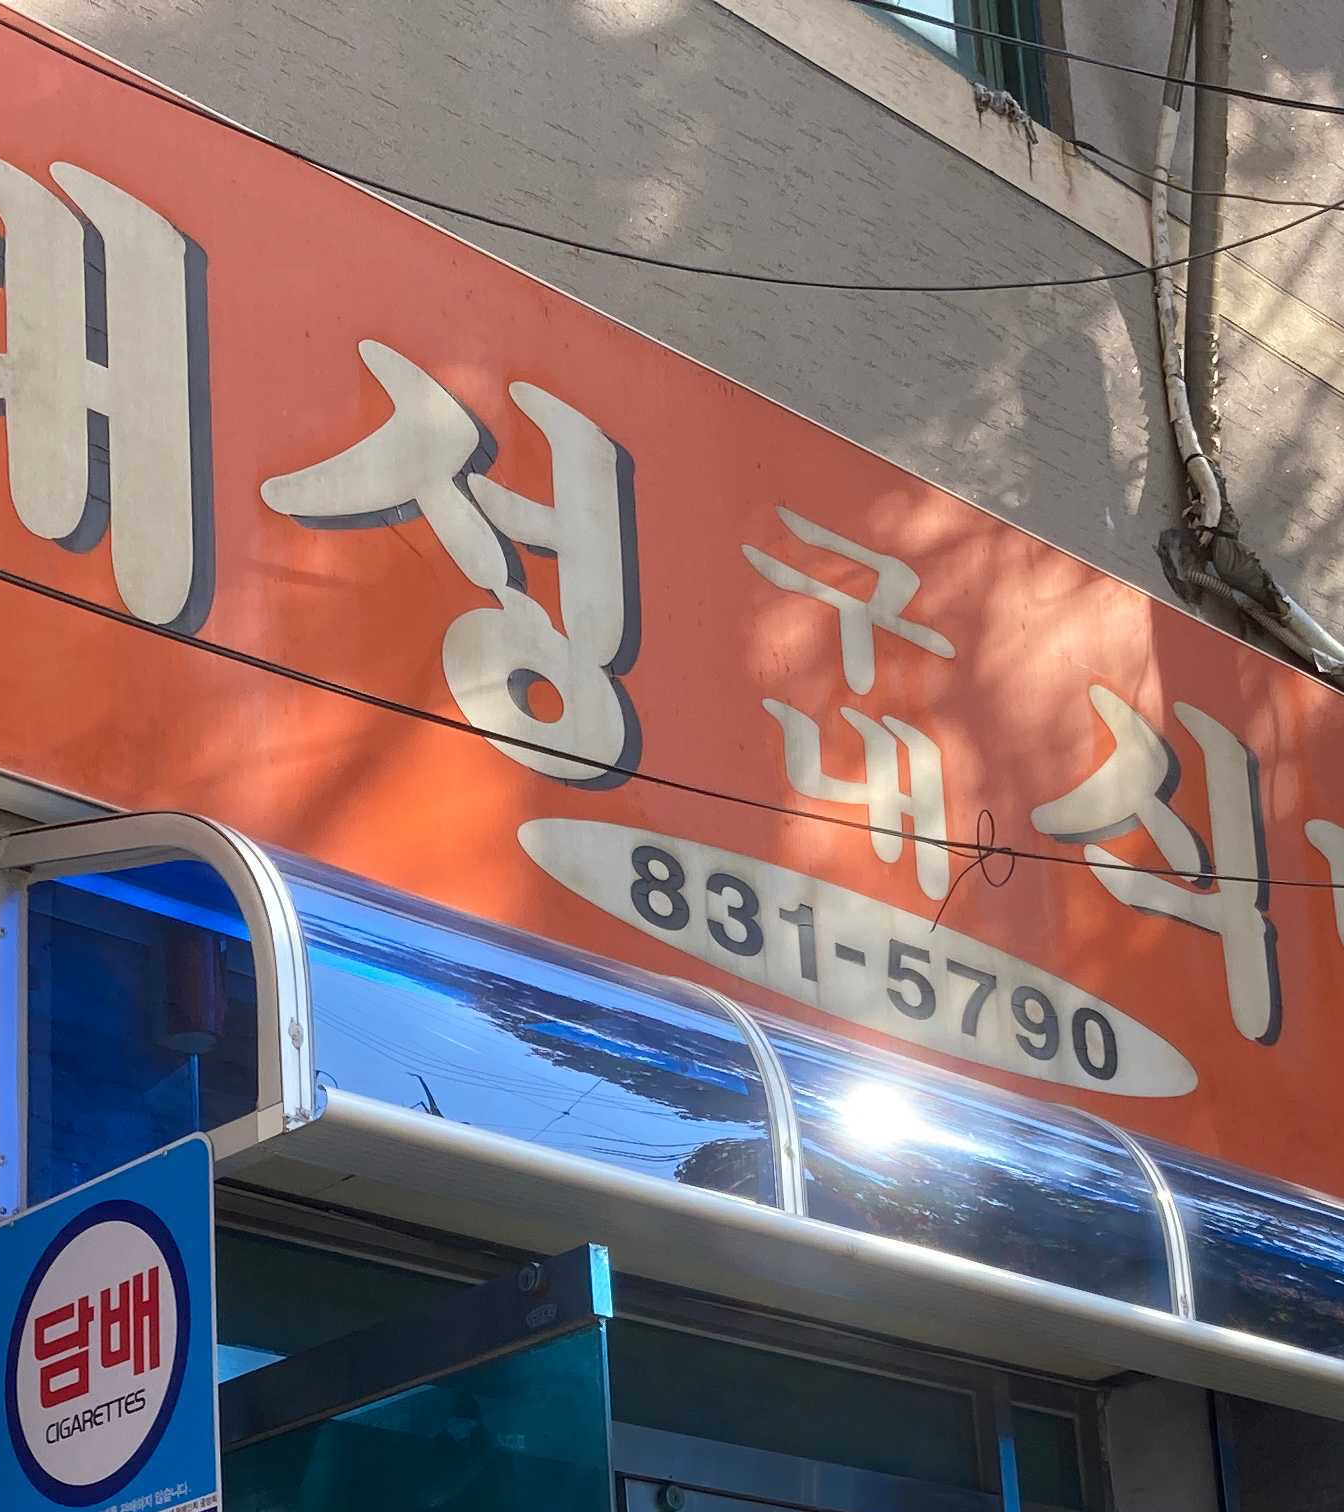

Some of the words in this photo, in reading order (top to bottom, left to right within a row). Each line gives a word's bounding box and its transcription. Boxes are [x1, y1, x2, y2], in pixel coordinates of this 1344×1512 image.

[741, 505, 956, 900] 구내
[630, 845, 1119, 1081] 831-5790
[34, 1266, 160, 1409] 담배
[46, 1389, 146, 1443] CIGARETTES
